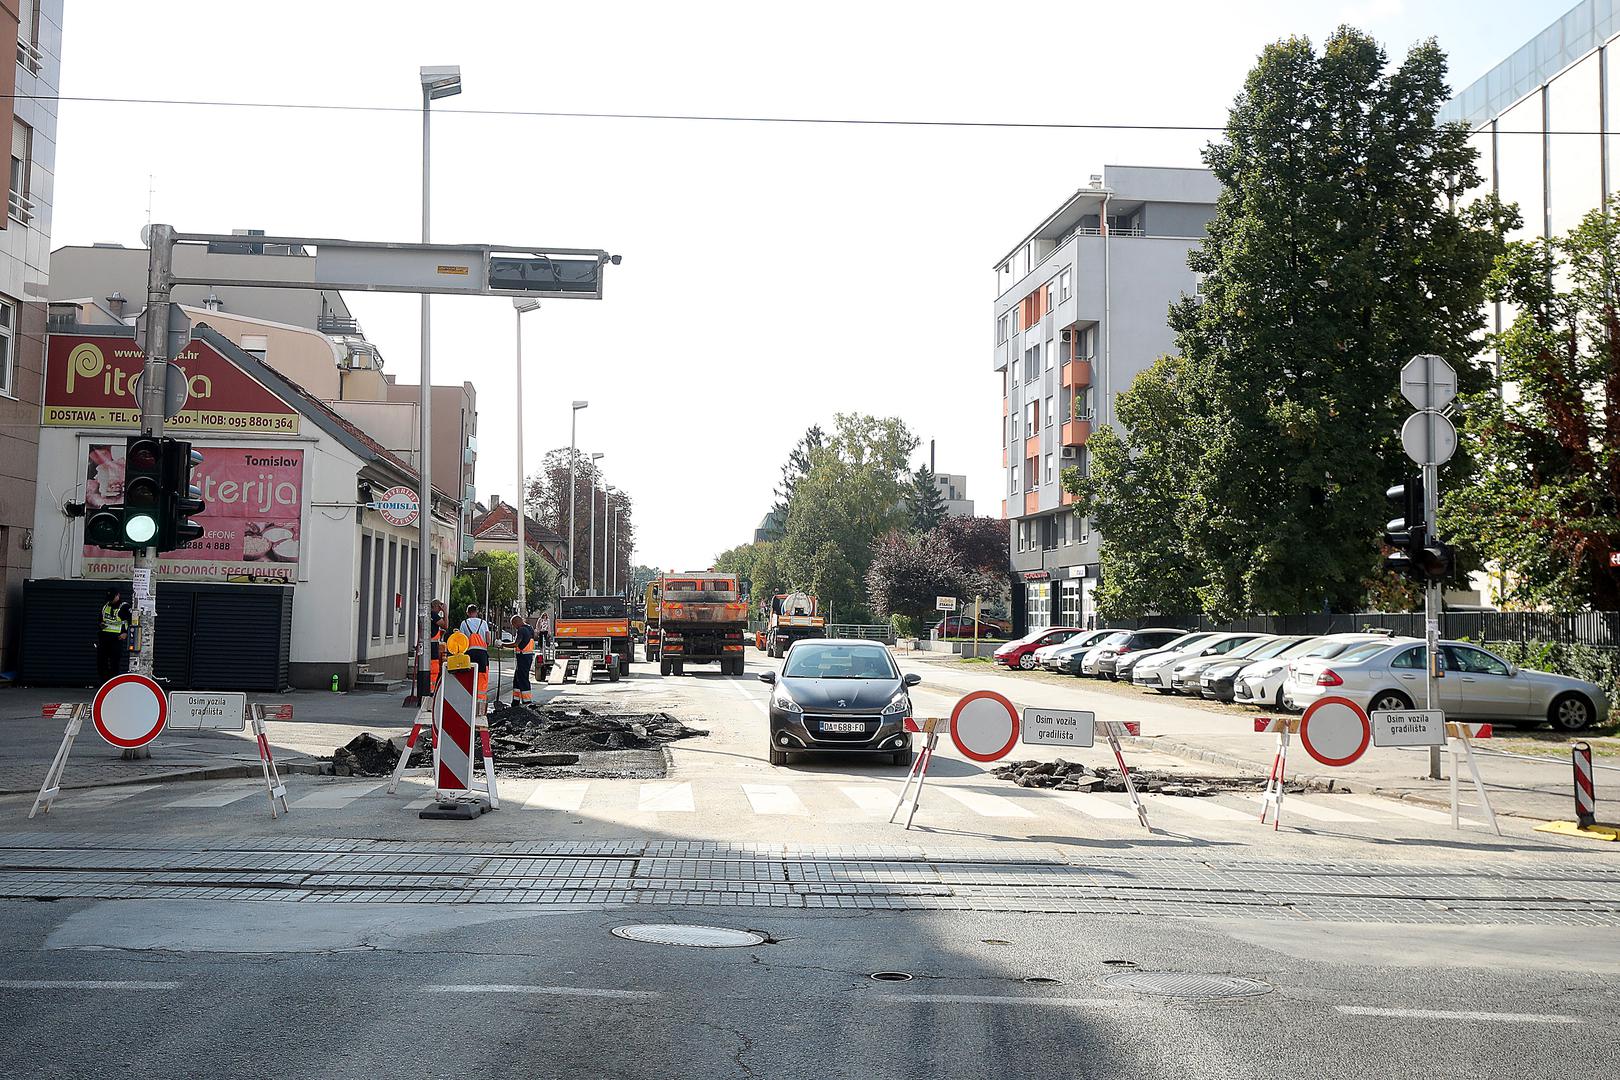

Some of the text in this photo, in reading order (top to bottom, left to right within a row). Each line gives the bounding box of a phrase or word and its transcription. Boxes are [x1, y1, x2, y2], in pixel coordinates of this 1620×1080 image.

[50, 410, 96, 421] DOSTAVA
[109, 412, 130, 422] TEL.
[172, 416, 190, 425] 500
[201, 415, 226, 425] MOB:
[229, 418, 246, 427] 095
[249, 417, 272, 427] 8801
[275, 418, 293, 429] 364
[245, 455, 298, 467] Tomislav
[190, 467, 297, 513] iterija
[202, 531, 236, 539] LEFONE
[214, 542, 230, 550] 888
[173, 563, 217, 575] DOMAĆI
[188, 697, 226, 706] Osim vozila
[1036, 714, 1077, 726] Osim vozila
[1386, 714, 1429, 723] Osim vozila
[1038, 730, 1074, 740] gradilišta
[1391, 725, 1426, 735] gradilišta
